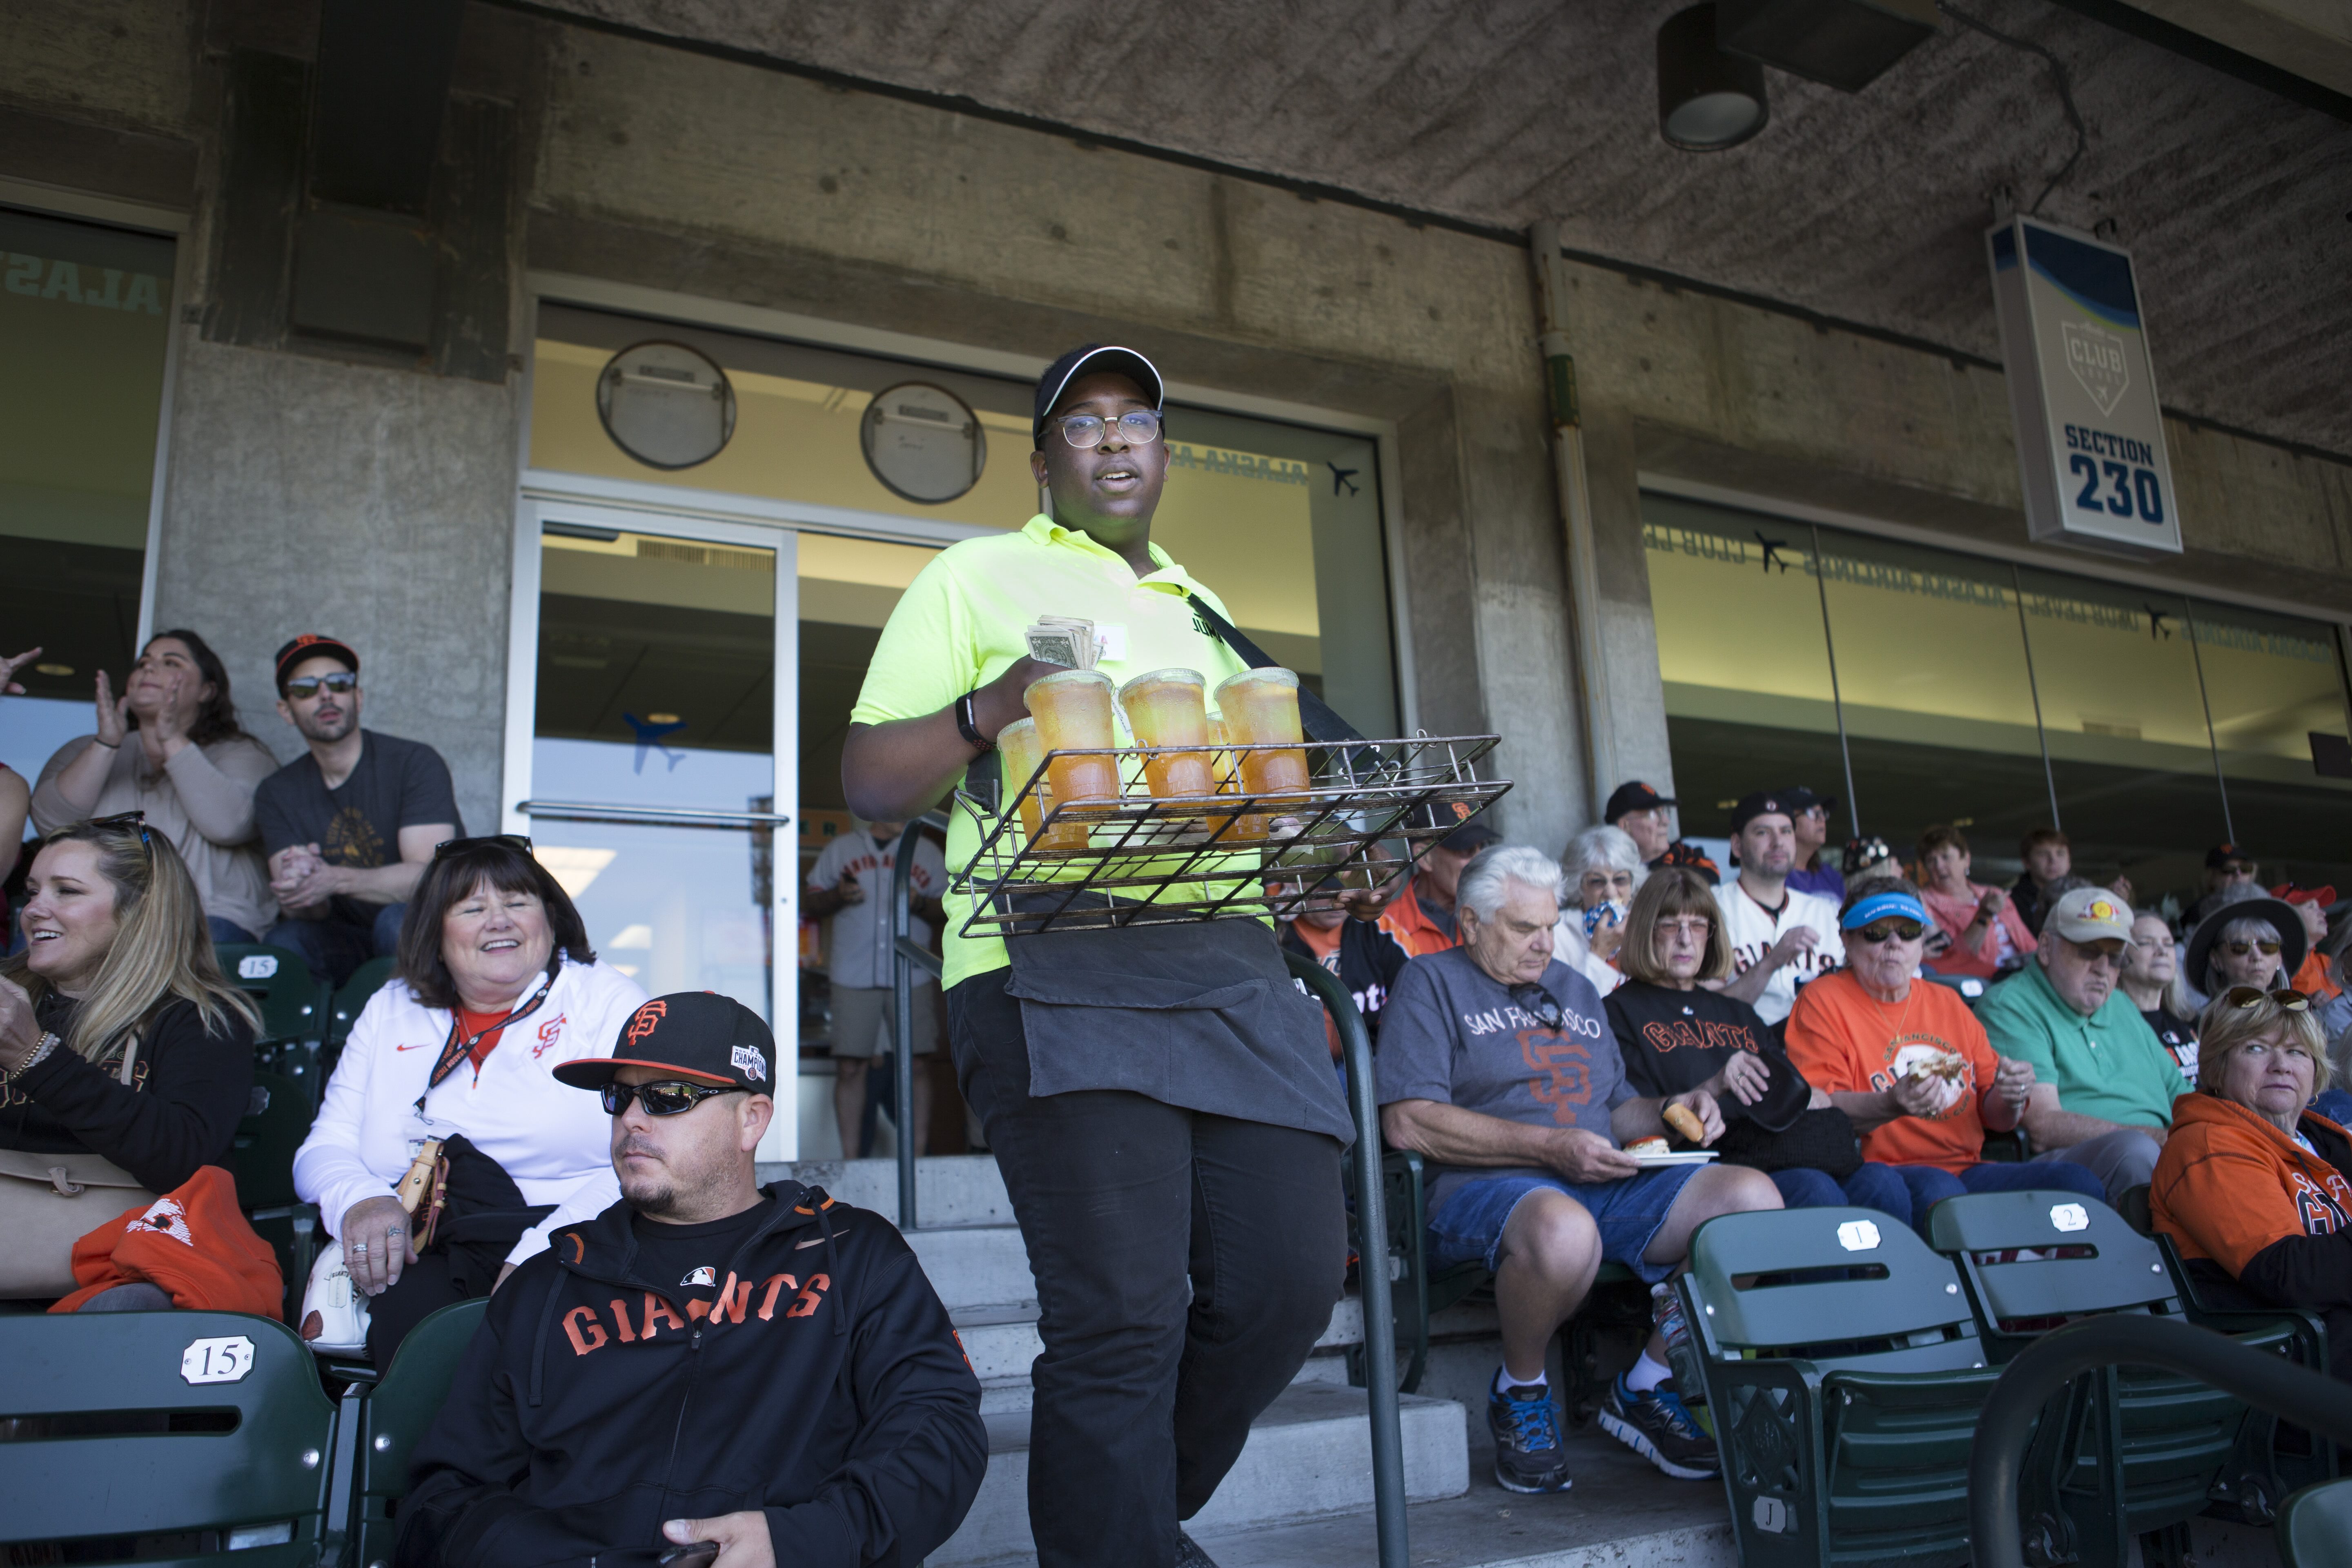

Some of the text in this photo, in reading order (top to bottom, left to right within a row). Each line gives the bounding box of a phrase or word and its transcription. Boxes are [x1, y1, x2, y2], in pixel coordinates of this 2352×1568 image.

[2071, 337, 2122, 372] CLUB
[2065, 424, 2154, 467] SECTION
[2069, 454, 2164, 525] 230
[249, 960, 270, 975] 15
[532, 1013, 567, 1060] SF
[627, 1000, 667, 1047] SF
[1464, 1007, 1601, 1038] SAN FRAISCO
[446, 1048, 467, 1069] SEASON
[1515, 1028, 1592, 1125] SF
[2062, 1209, 2076, 1226] 2
[1854, 1226, 1863, 1244] 1
[563, 1271, 831, 1356] GIANTS
[199, 1343, 240, 1376] 15
[1766, 1503, 1773, 1526] J
